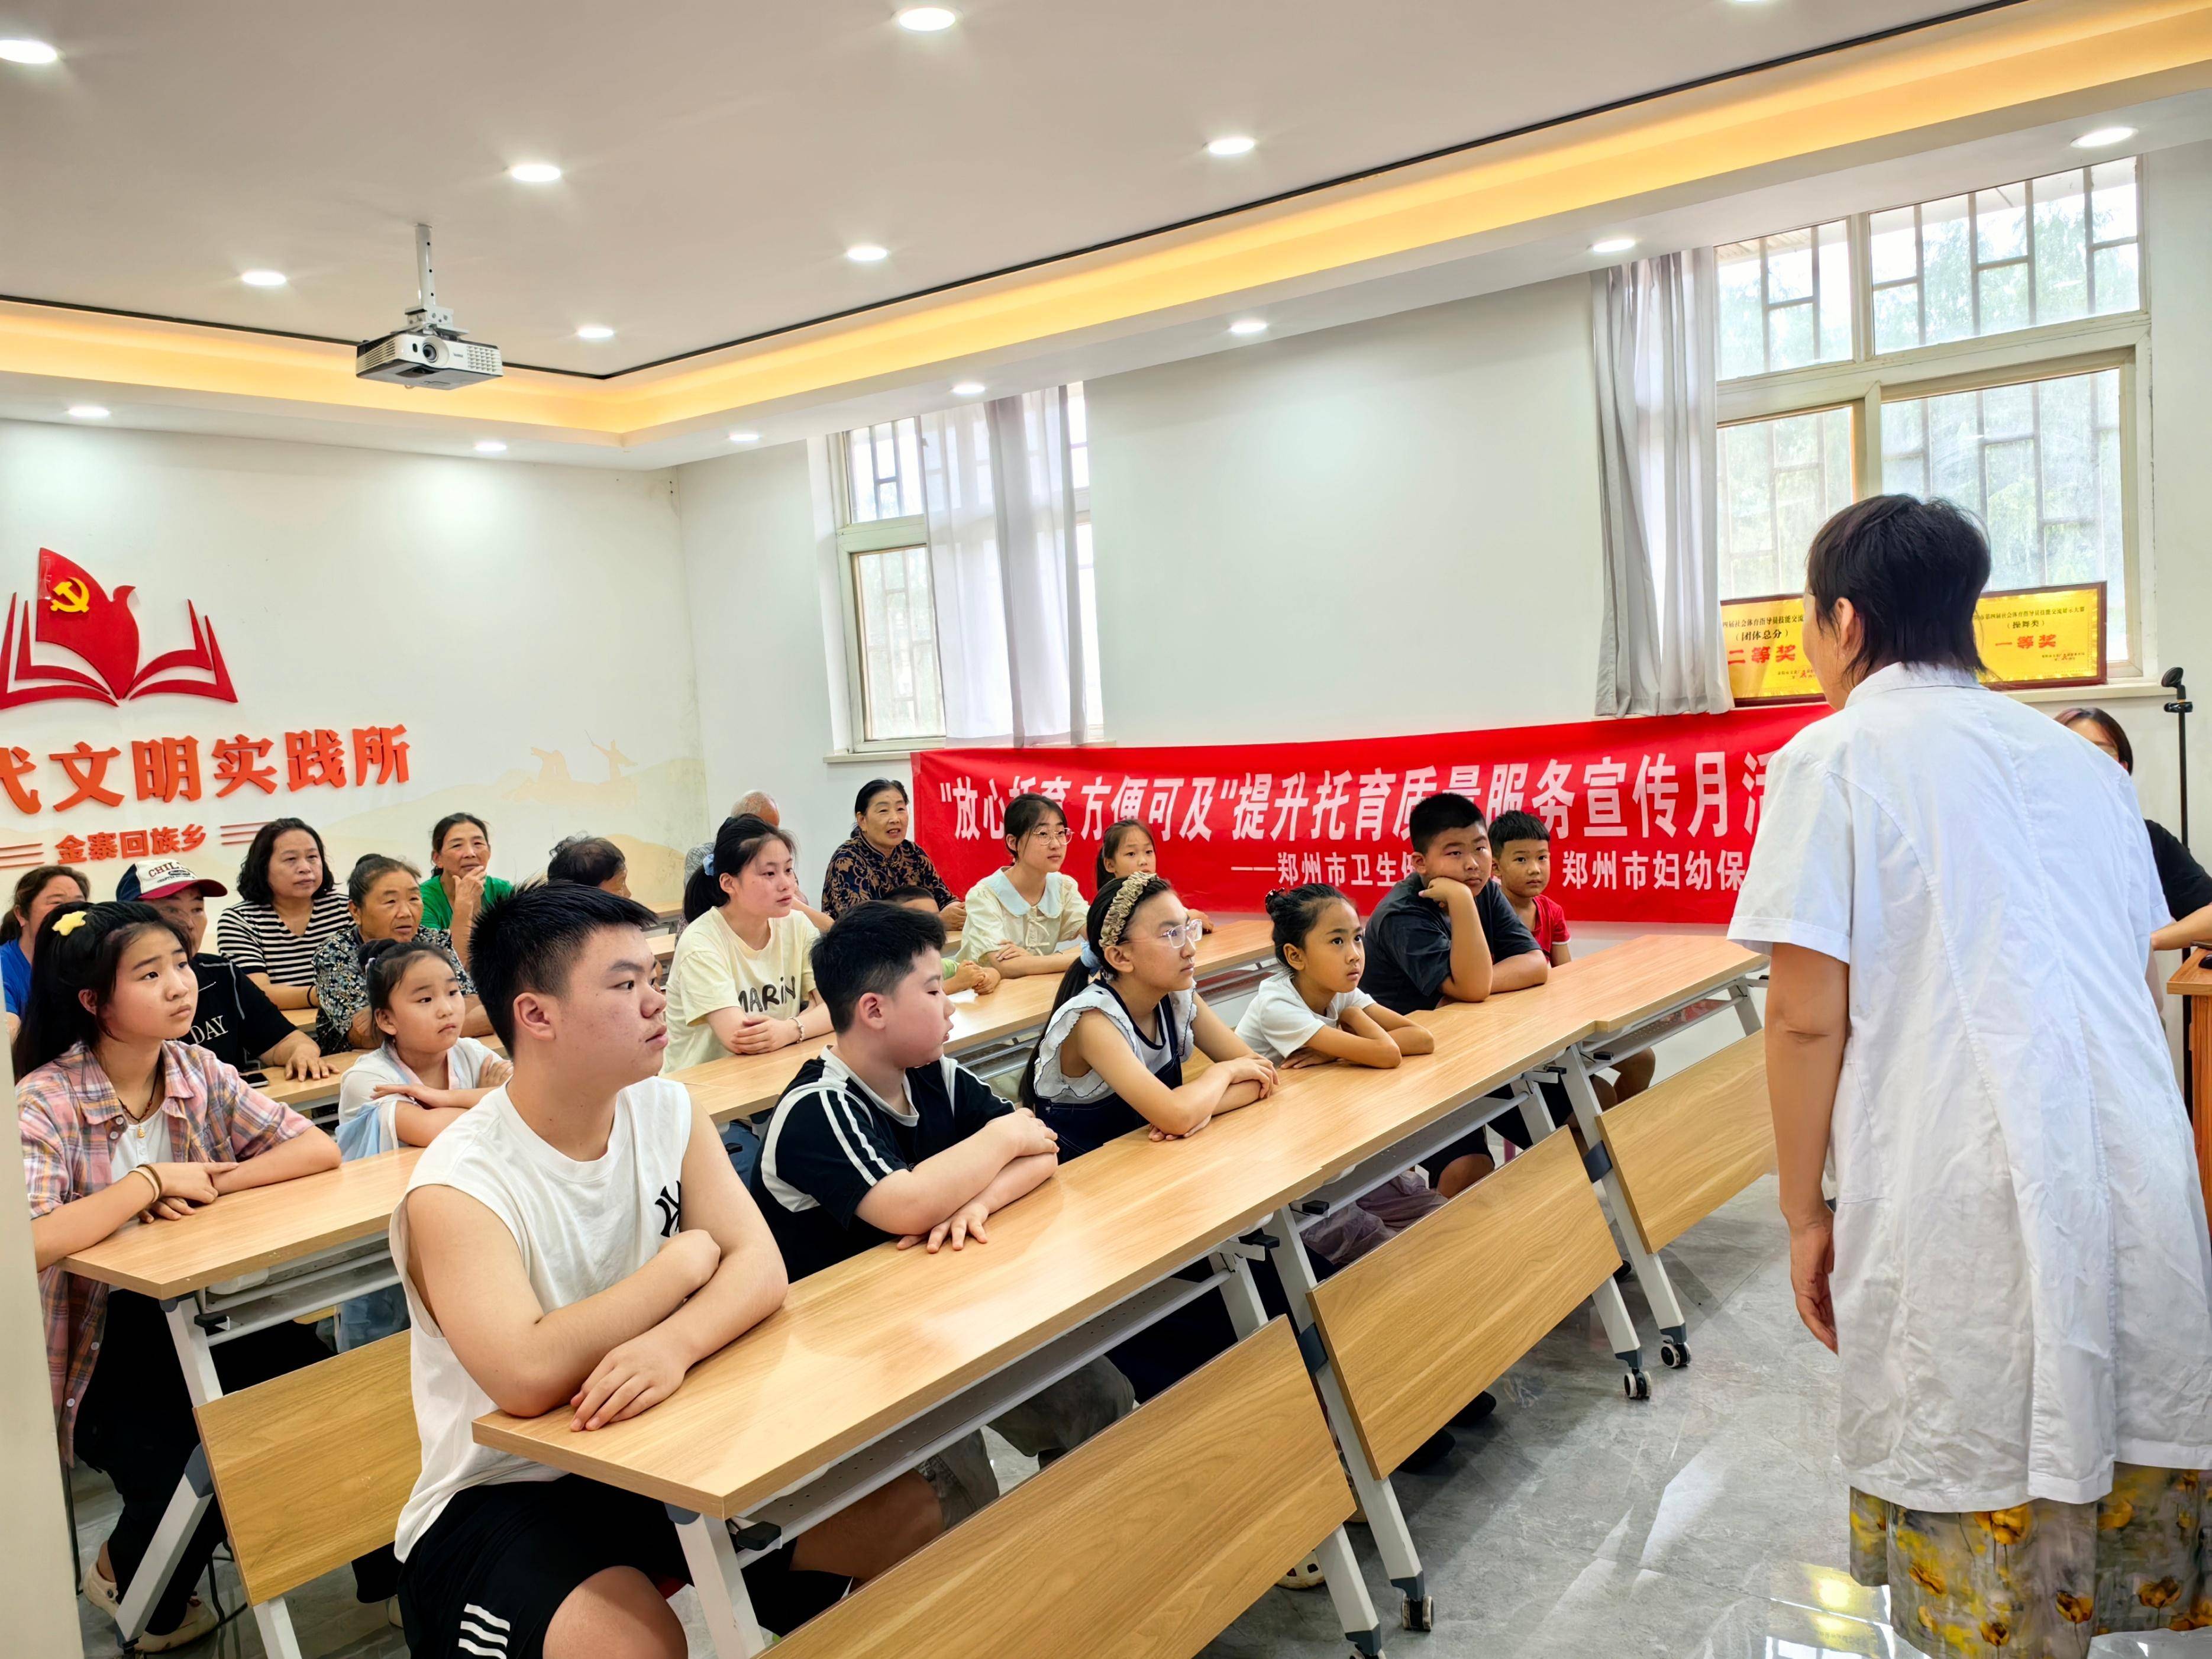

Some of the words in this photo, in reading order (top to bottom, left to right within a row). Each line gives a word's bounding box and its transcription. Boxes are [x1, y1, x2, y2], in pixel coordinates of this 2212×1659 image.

[1995, 634, 2057, 649] 一等奖
[1727, 644, 1796, 665] 二等奖
[55, 824, 206, 864] 金寨回族乡
